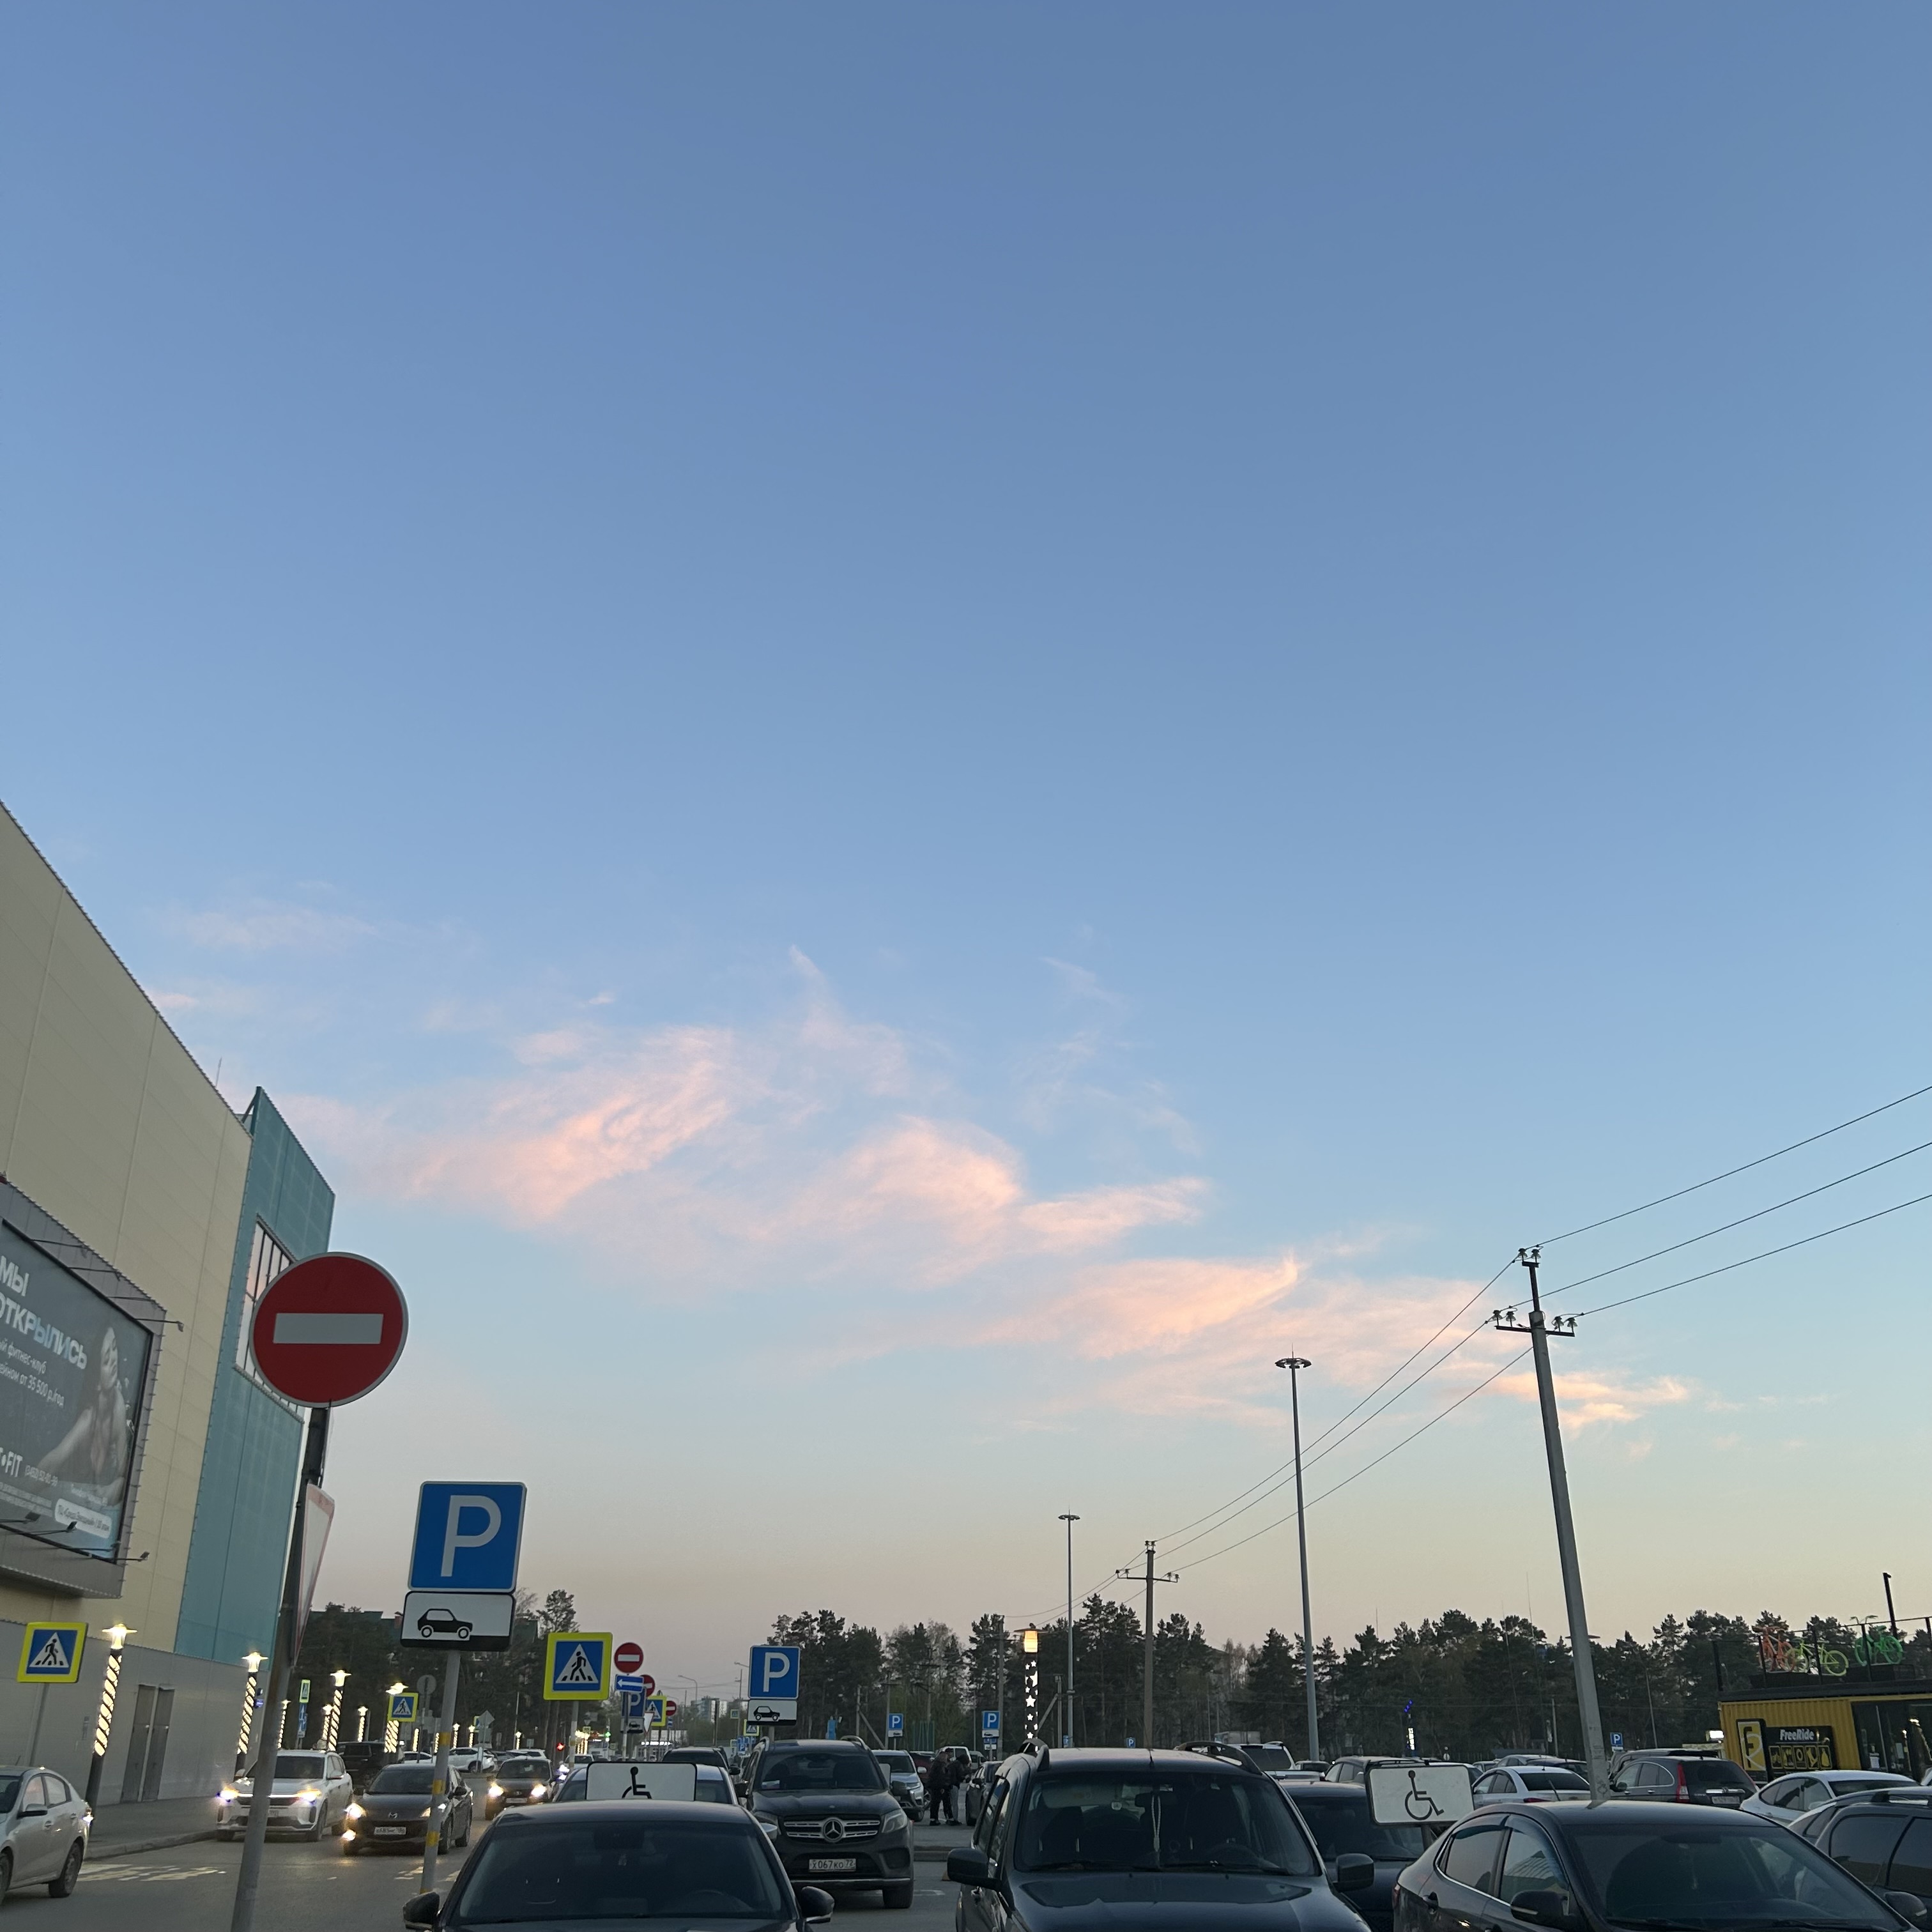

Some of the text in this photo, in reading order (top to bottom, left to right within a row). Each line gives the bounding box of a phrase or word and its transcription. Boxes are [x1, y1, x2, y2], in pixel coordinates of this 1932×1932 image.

[0, 1255, 29, 1297] МЫ
[8, 1341, 47, 1374] фитнес-клуб
[20, 1374, 28, 1386] от
[27, 1374, 36, 1391] 35
[36, 1379, 49, 1397] 500
[441, 1495, 502, 1577] P
[763, 1652, 790, 1692] P
[628, 1692, 641, 1717] P
[892, 1715, 900, 1728] P
[987, 1713, 997, 1728] P
[1128, 1738, 1134, 1747] P
[1614, 1734, 1620, 1744] P
[1779, 1728, 1814, 1741] FreeRide
